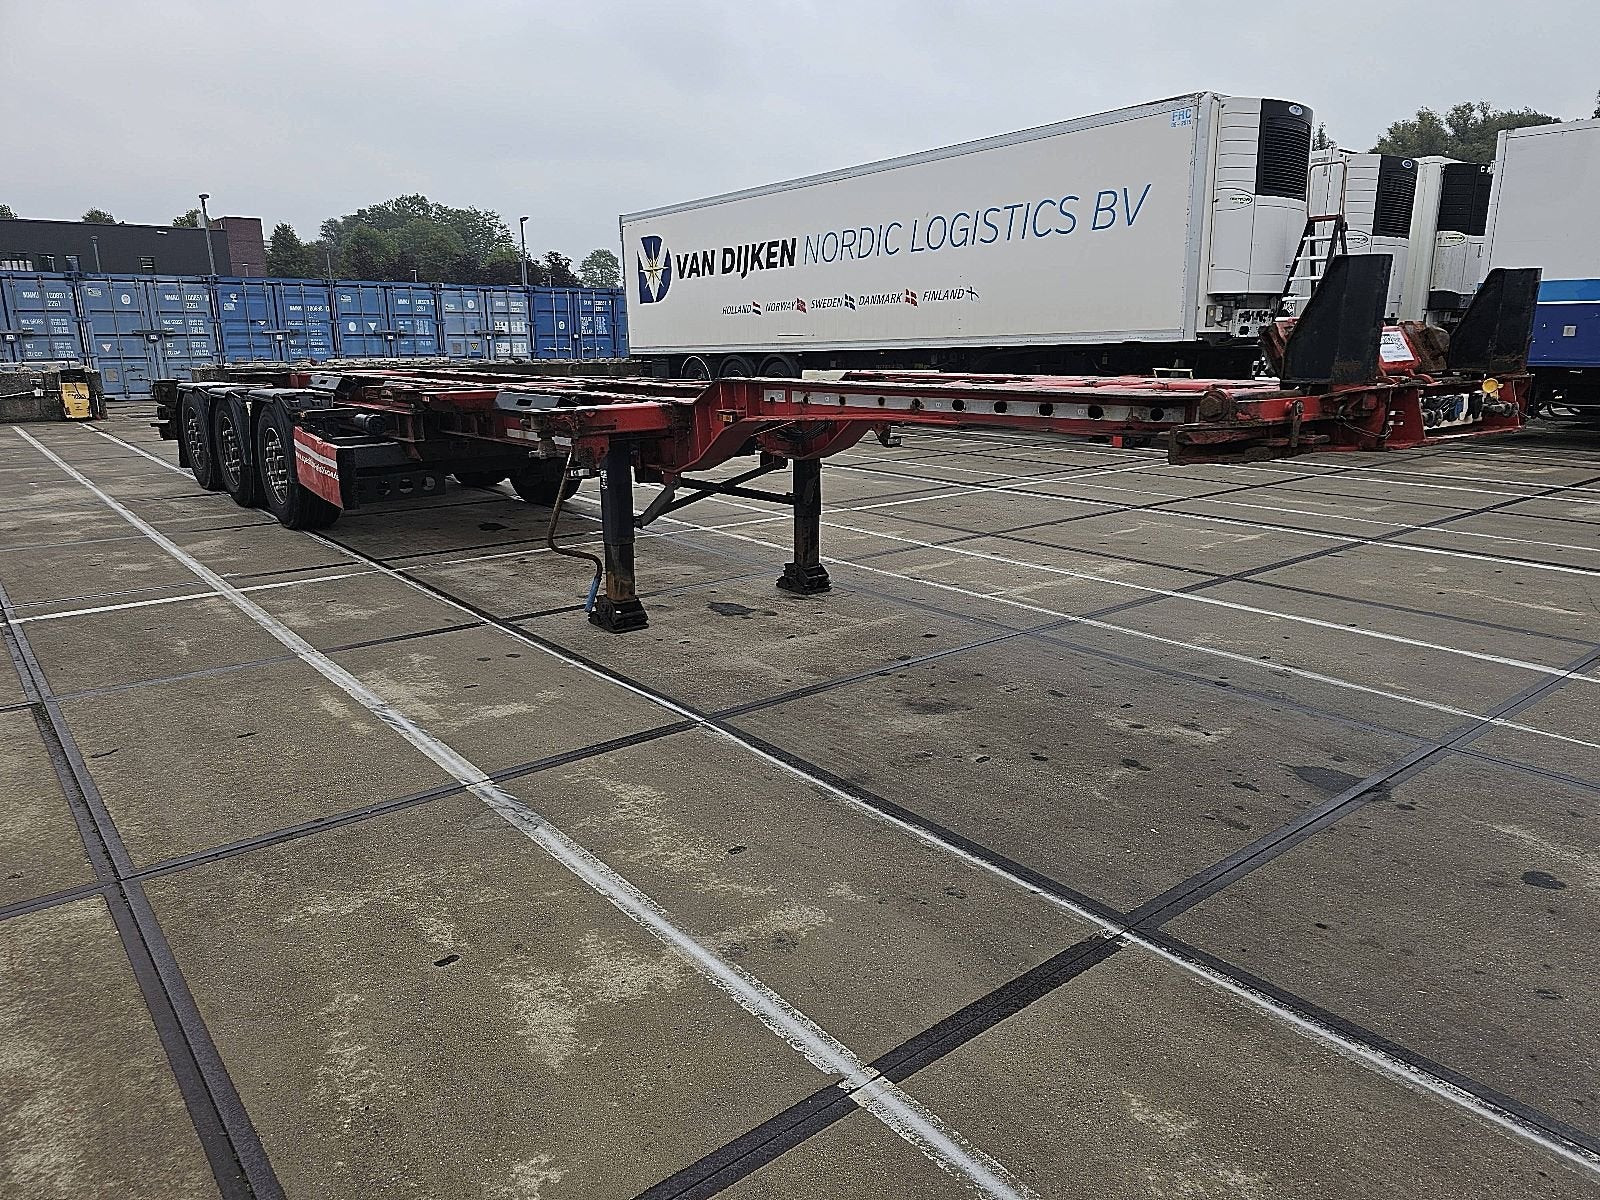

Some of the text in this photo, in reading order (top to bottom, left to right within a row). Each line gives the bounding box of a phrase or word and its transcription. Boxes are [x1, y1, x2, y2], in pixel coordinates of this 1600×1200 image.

[1172, 109, 1191, 121] FRC
[676, 184, 1151, 279] VAN DIJKEN NORDIC LOGISTICS BV
[722, 288, 964, 315] HOLLAND NORWAY SWEDEN DANMARK FINLAND
